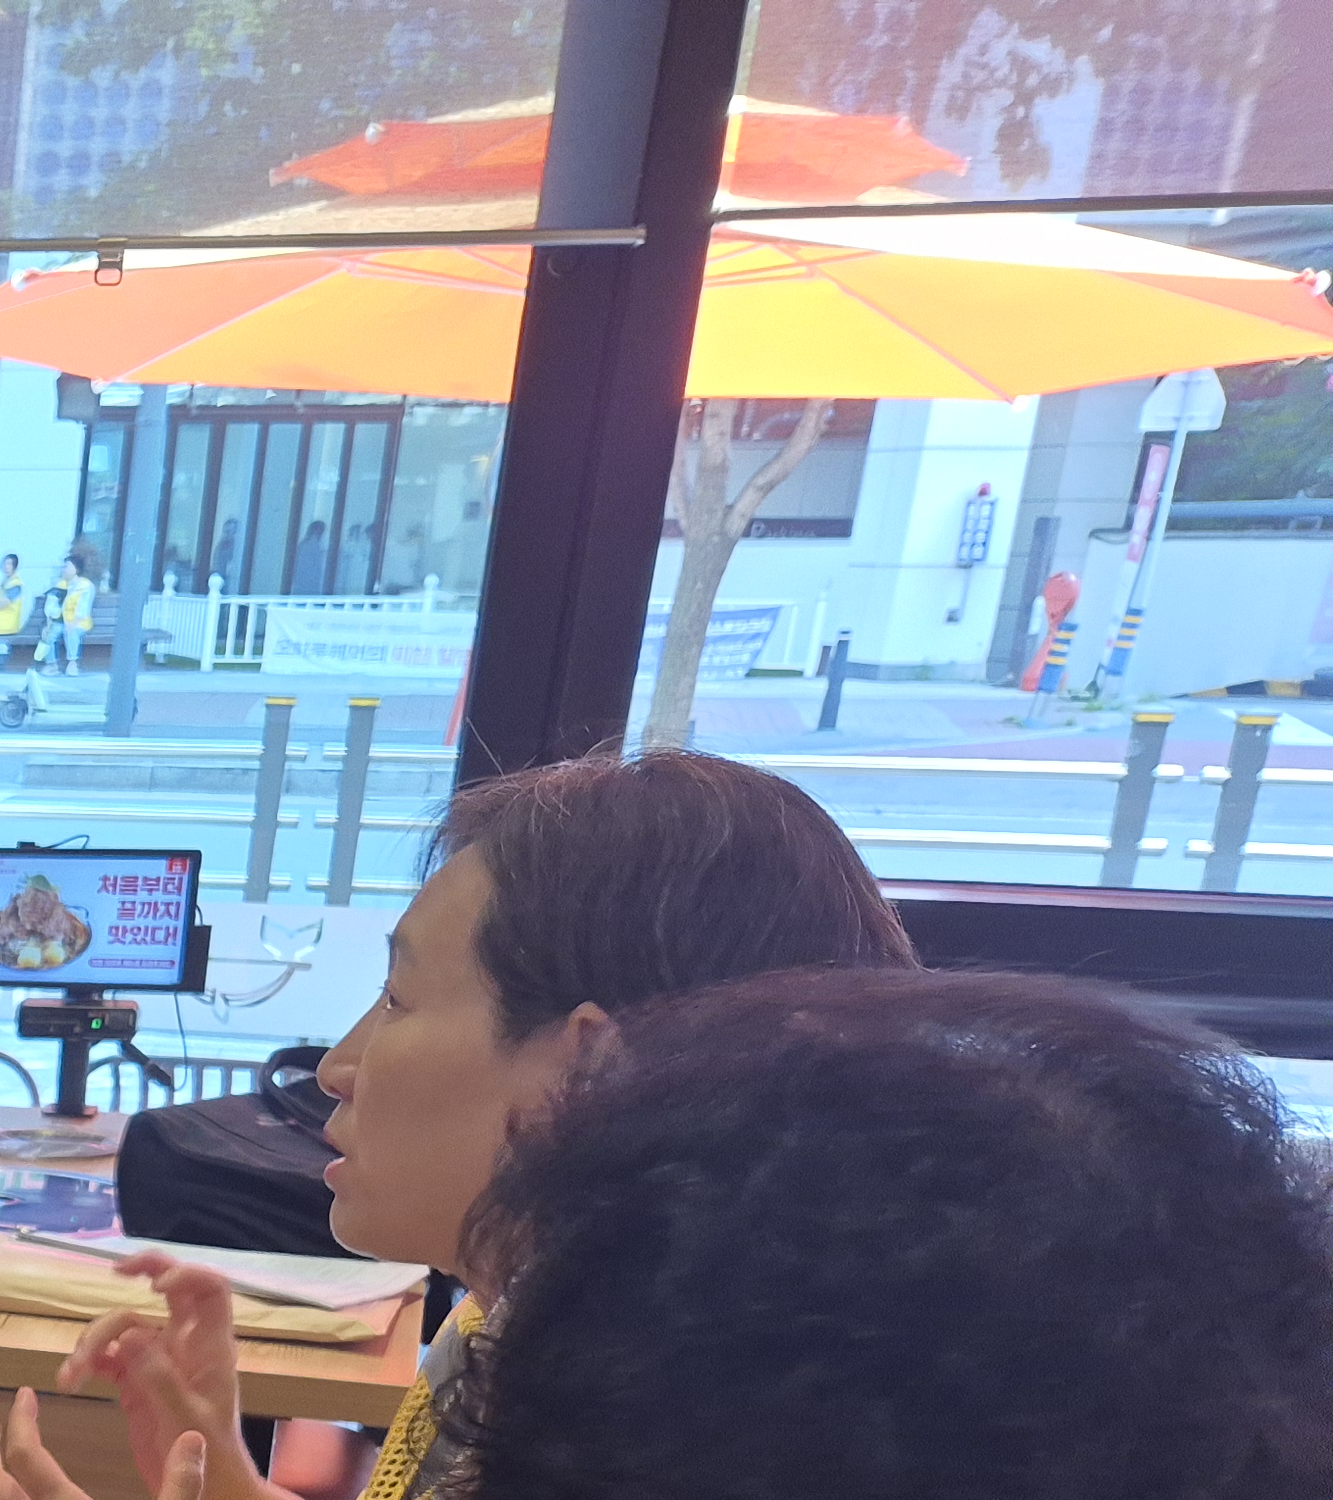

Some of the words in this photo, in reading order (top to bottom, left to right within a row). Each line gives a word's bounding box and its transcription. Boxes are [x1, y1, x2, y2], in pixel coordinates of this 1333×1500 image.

[97, 875, 184, 897] 처음부터
[117, 900, 180, 921] 끝까지
[108, 925, 177, 947] 맛있다!
